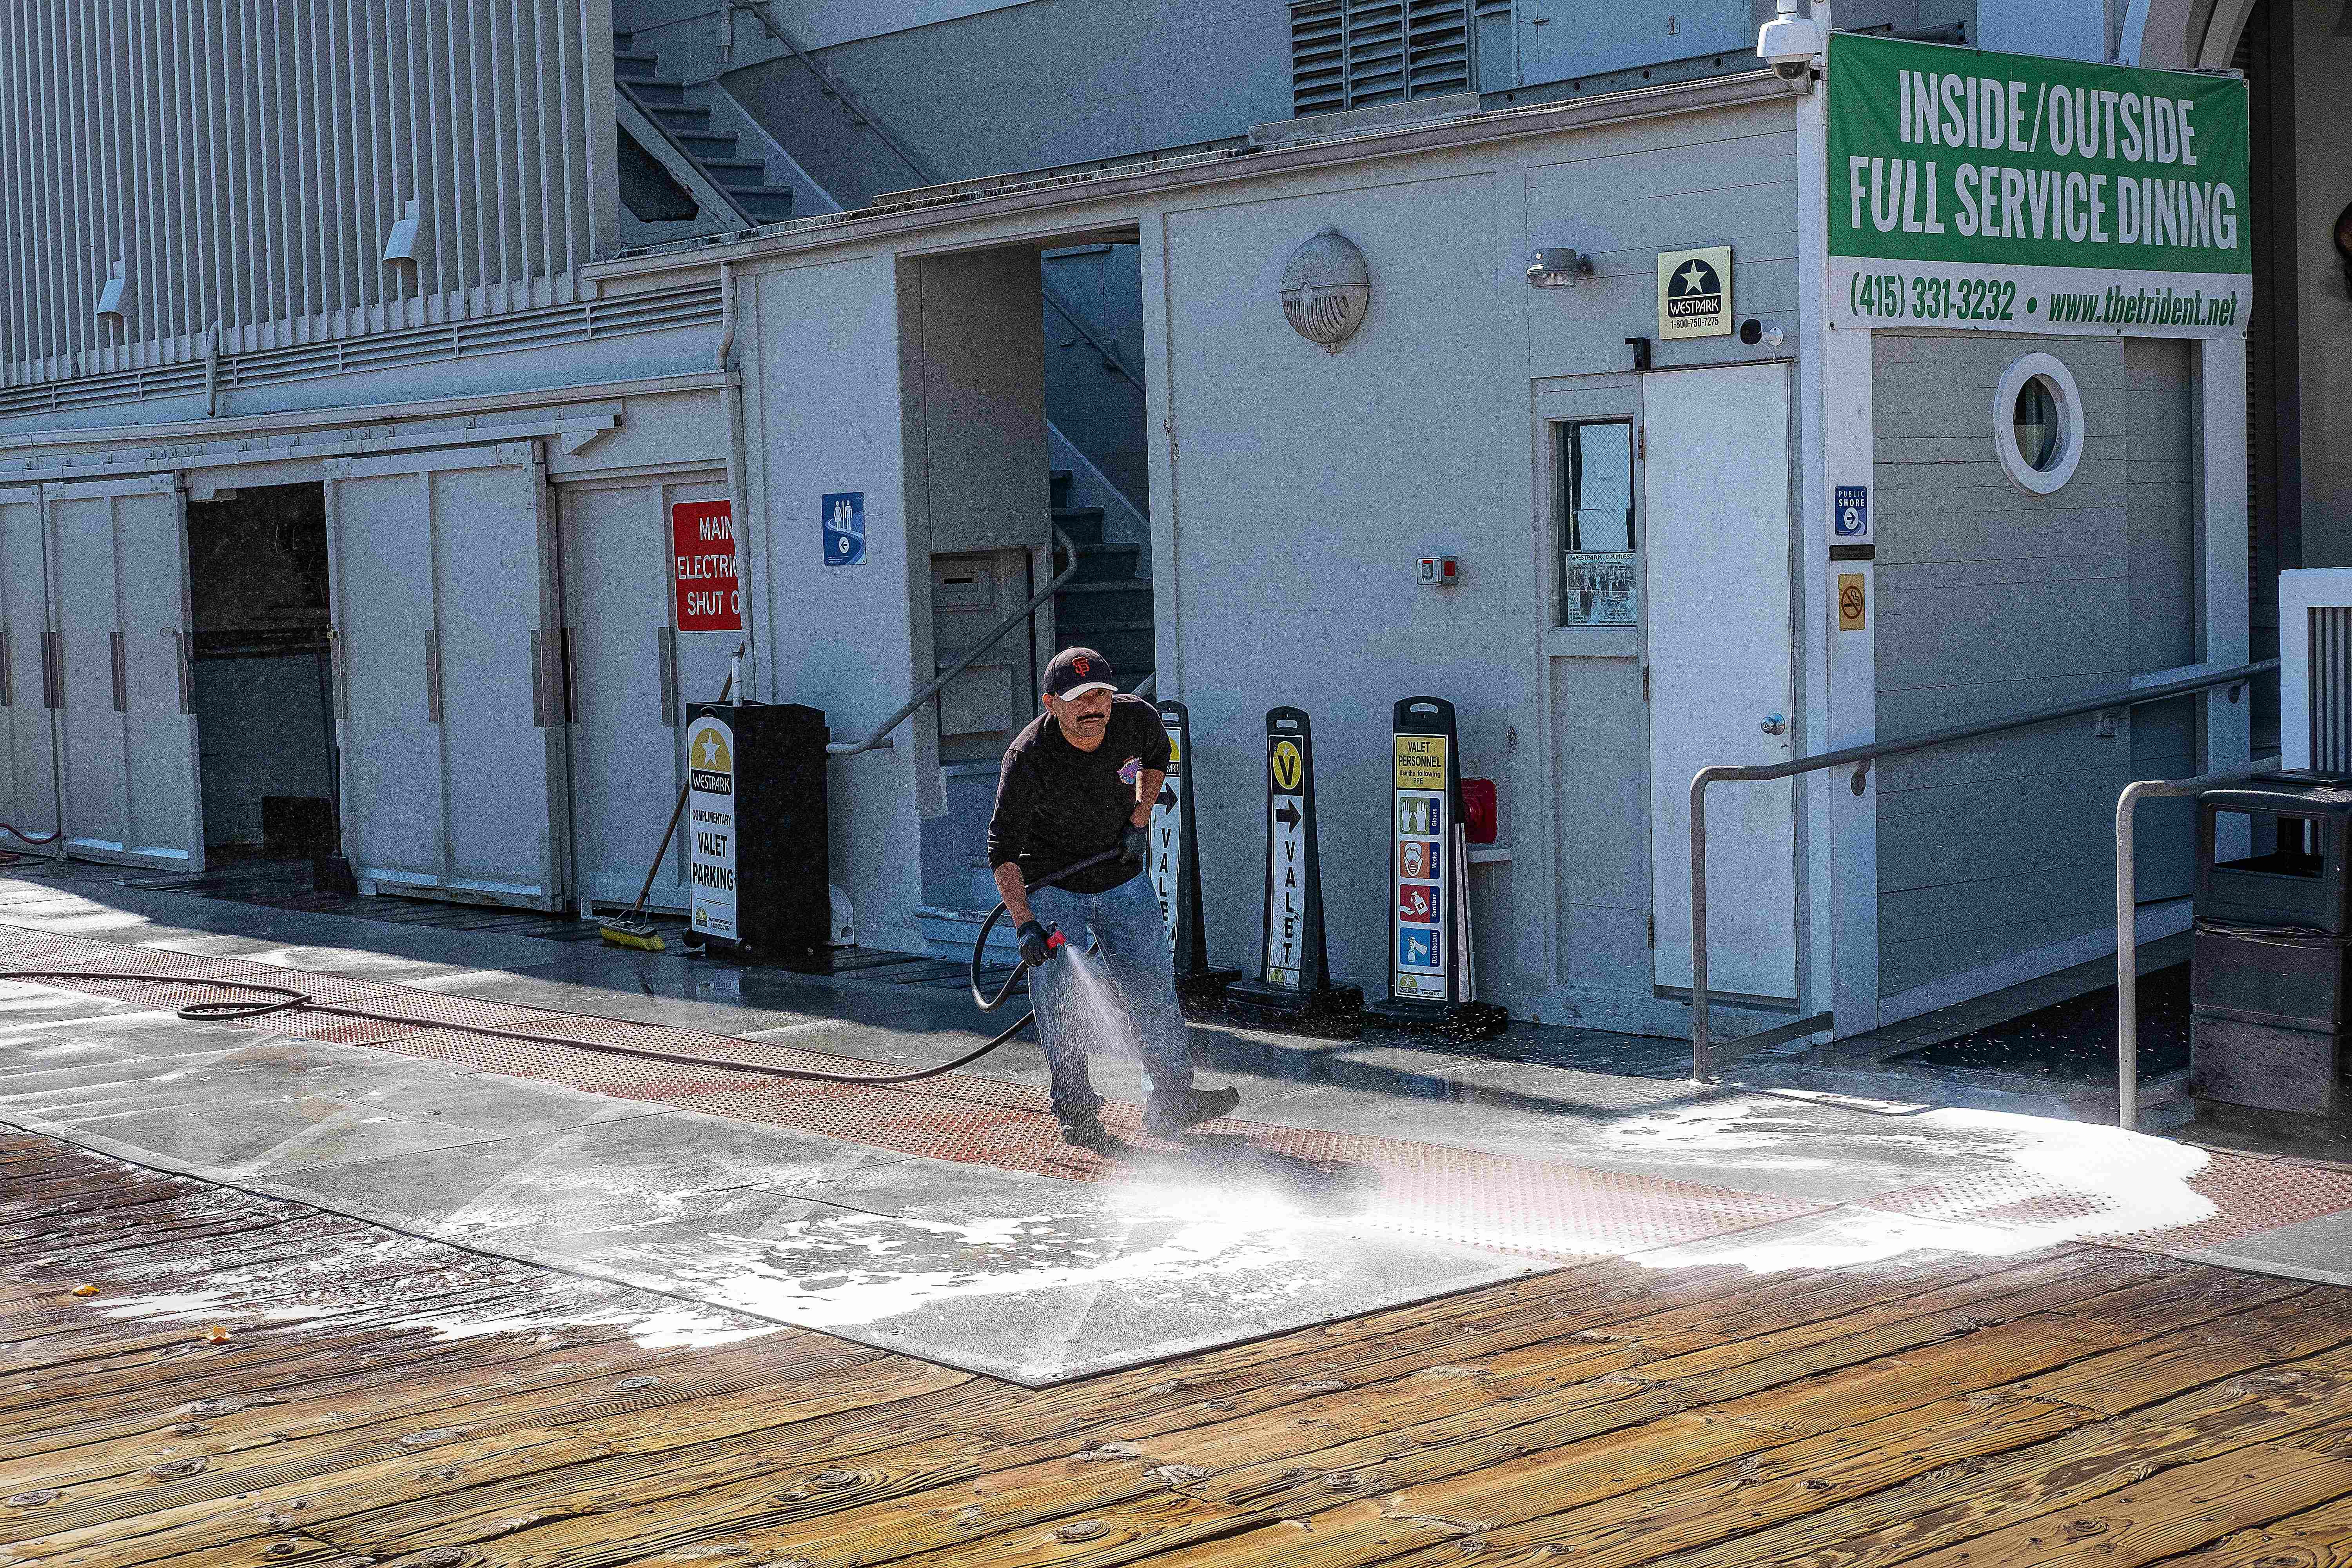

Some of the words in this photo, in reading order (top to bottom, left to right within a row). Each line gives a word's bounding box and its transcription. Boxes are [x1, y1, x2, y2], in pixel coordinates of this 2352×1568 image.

[1900, 70, 2197, 165] INSIDE/OUTSIDE
[1849, 156, 1945, 234] FULL
[1955, 163, 2108, 243] SERVICE
[2118, 176, 2238, 250] DINING
[1670, 298, 1719, 315] WESTPARK
[1851, 272, 1905, 318] (415)
[1911, 276, 2016, 321] 331-3232
[2050, 286, 2238, 327] www.thetrident.net
[1670, 316, 1719, 329] 1-800-750-7275
[699, 516, 734, 541] MAIN
[687, 591, 724, 615] SHUT
[1408, 742, 1431, 753] VALET
[1277, 755, 1296, 785] V
[1399, 755, 1442, 767] PERSONNEL
[693, 773, 730, 792] WESTPARK
[1417, 770, 1441, 779] following
[692, 809, 731, 826] COMPLIMENTARY
[697, 831, 728, 858] VALET
[693, 862, 734, 891] PARKING
[1283, 840, 1296, 964] VALET
